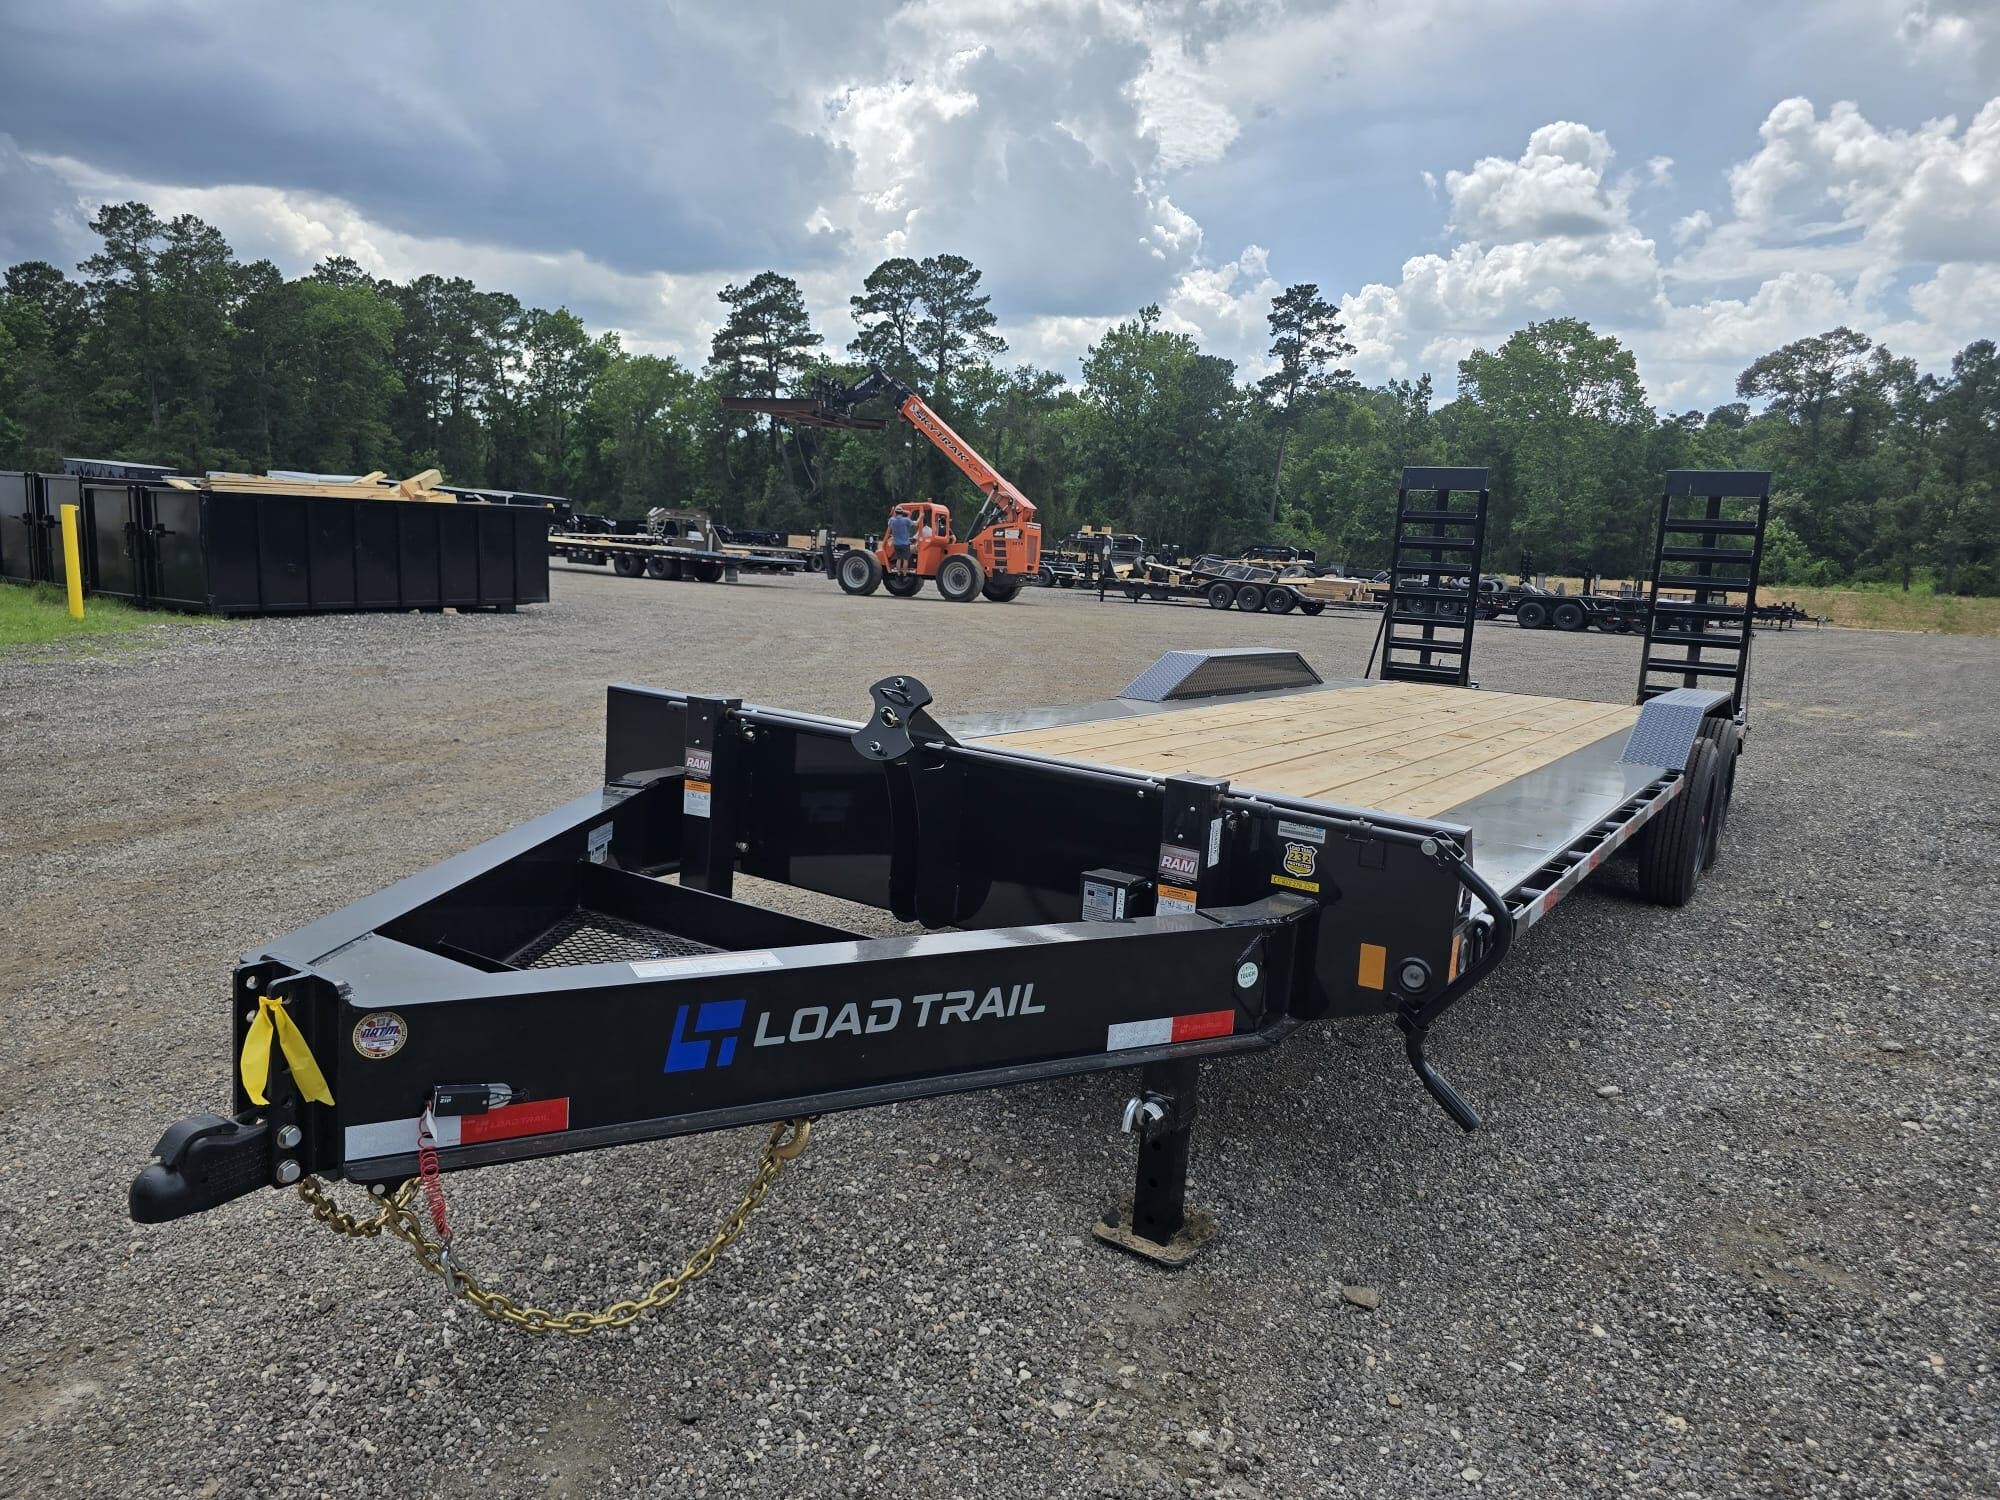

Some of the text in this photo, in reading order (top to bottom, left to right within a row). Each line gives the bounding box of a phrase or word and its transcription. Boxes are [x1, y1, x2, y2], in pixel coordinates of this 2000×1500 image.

[913, 410, 970, 463] SKYTRAK
[686, 757, 710, 771] RAM
[1160, 855, 1196, 874] RAM
[753, 983, 1046, 1047] LOAD TRAIL
